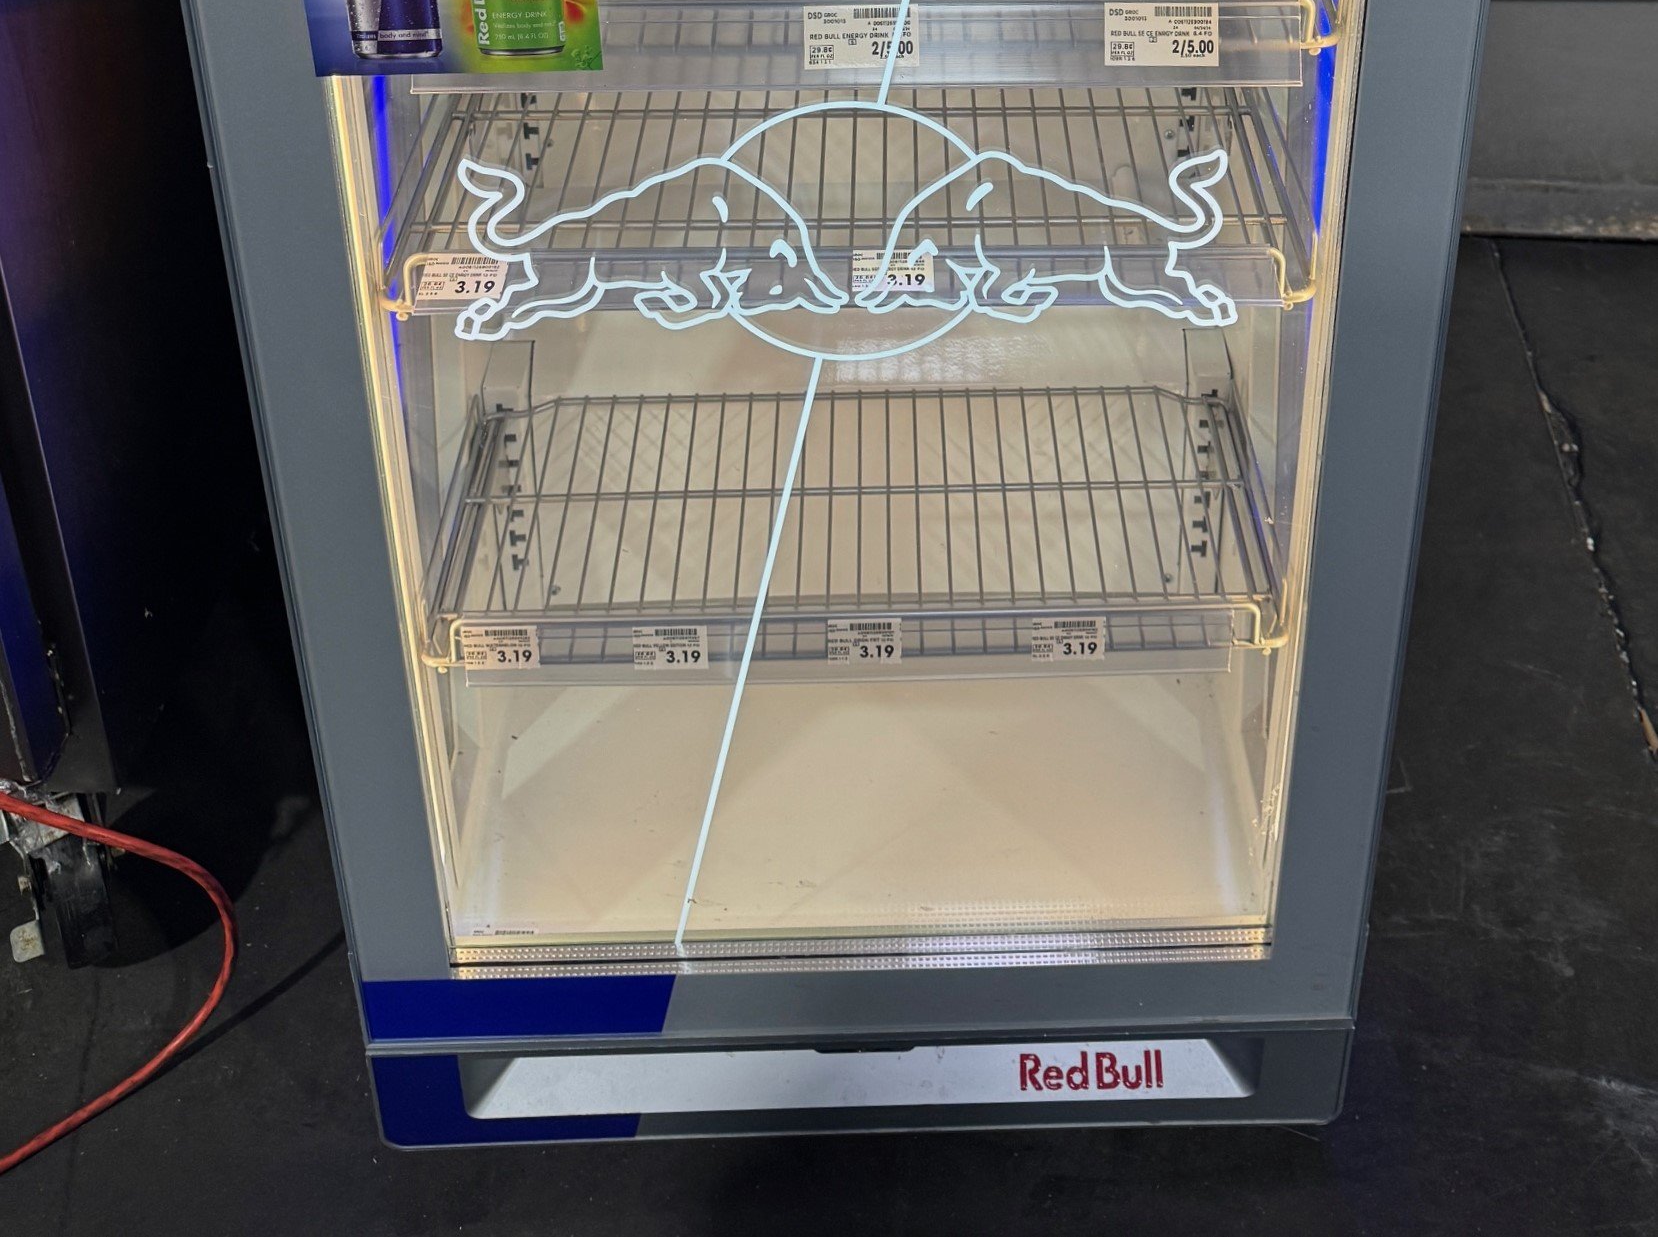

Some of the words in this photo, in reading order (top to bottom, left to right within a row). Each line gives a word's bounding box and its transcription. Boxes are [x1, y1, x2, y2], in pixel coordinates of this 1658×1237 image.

[492, 11, 523, 19] ENERGY
[807, 12, 823, 20] DSD
[1109, 8, 1124, 16] DSD
[475, 8, 490, 45] Red
[1171, 39, 1214, 55] 2/5.00
[455, 280, 496, 294] 3.19
[860, 644, 895, 658] 3.19
[1063, 641, 1098, 655] 3.19
[497, 649, 532, 663] 3.19
[666, 650, 701, 664] 3.19
[1019, 1050, 1090, 1091] Red
[1095, 1049, 1164, 1089] Bull
